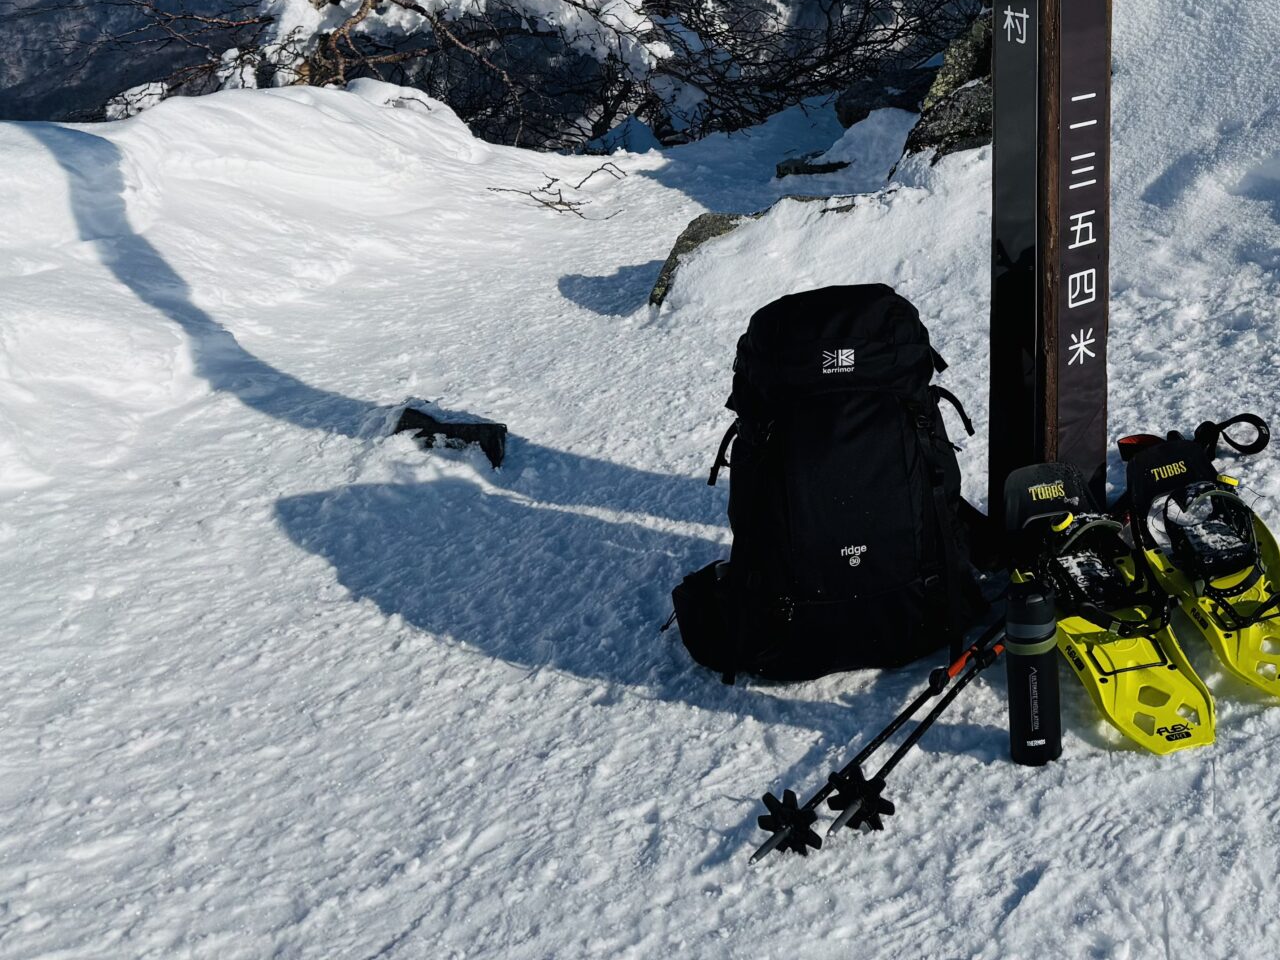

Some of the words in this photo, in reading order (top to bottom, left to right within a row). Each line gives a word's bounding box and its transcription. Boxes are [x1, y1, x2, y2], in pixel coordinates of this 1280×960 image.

[1067, 92, 1098, 366] 二三五四米
[822, 366, 855, 374] karrimor
[1151, 460, 1187, 481] TUBBS
[1028, 483, 1066, 501] TUBBS
[840, 544, 867, 557] ridge
[1156, 722, 1190, 736] FLEX
